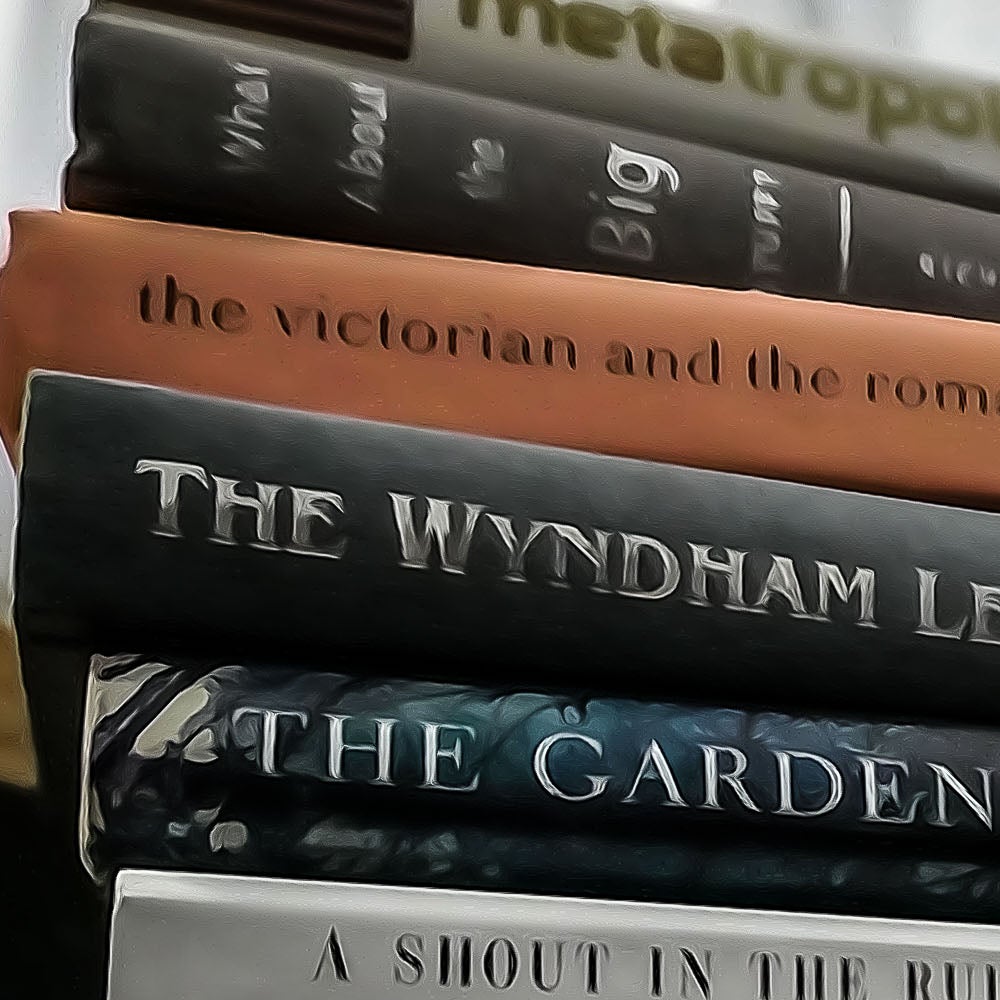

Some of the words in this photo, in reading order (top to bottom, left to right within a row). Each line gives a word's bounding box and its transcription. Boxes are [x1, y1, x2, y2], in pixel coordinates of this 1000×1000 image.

[589, 140, 681, 262] Big
[138, 273, 249, 333] the
[273, 299, 578, 371] victorian
[603, 336, 723, 387] and
[747, 343, 842, 399] the
[132, 458, 345, 560] THE
[387, 490, 883, 630] WYNDHAM
[231, 705, 481, 793] THE
[310, 924, 351, 984] A
[394, 931, 610, 996] SHOUT
[648, 944, 714, 1000] IN
